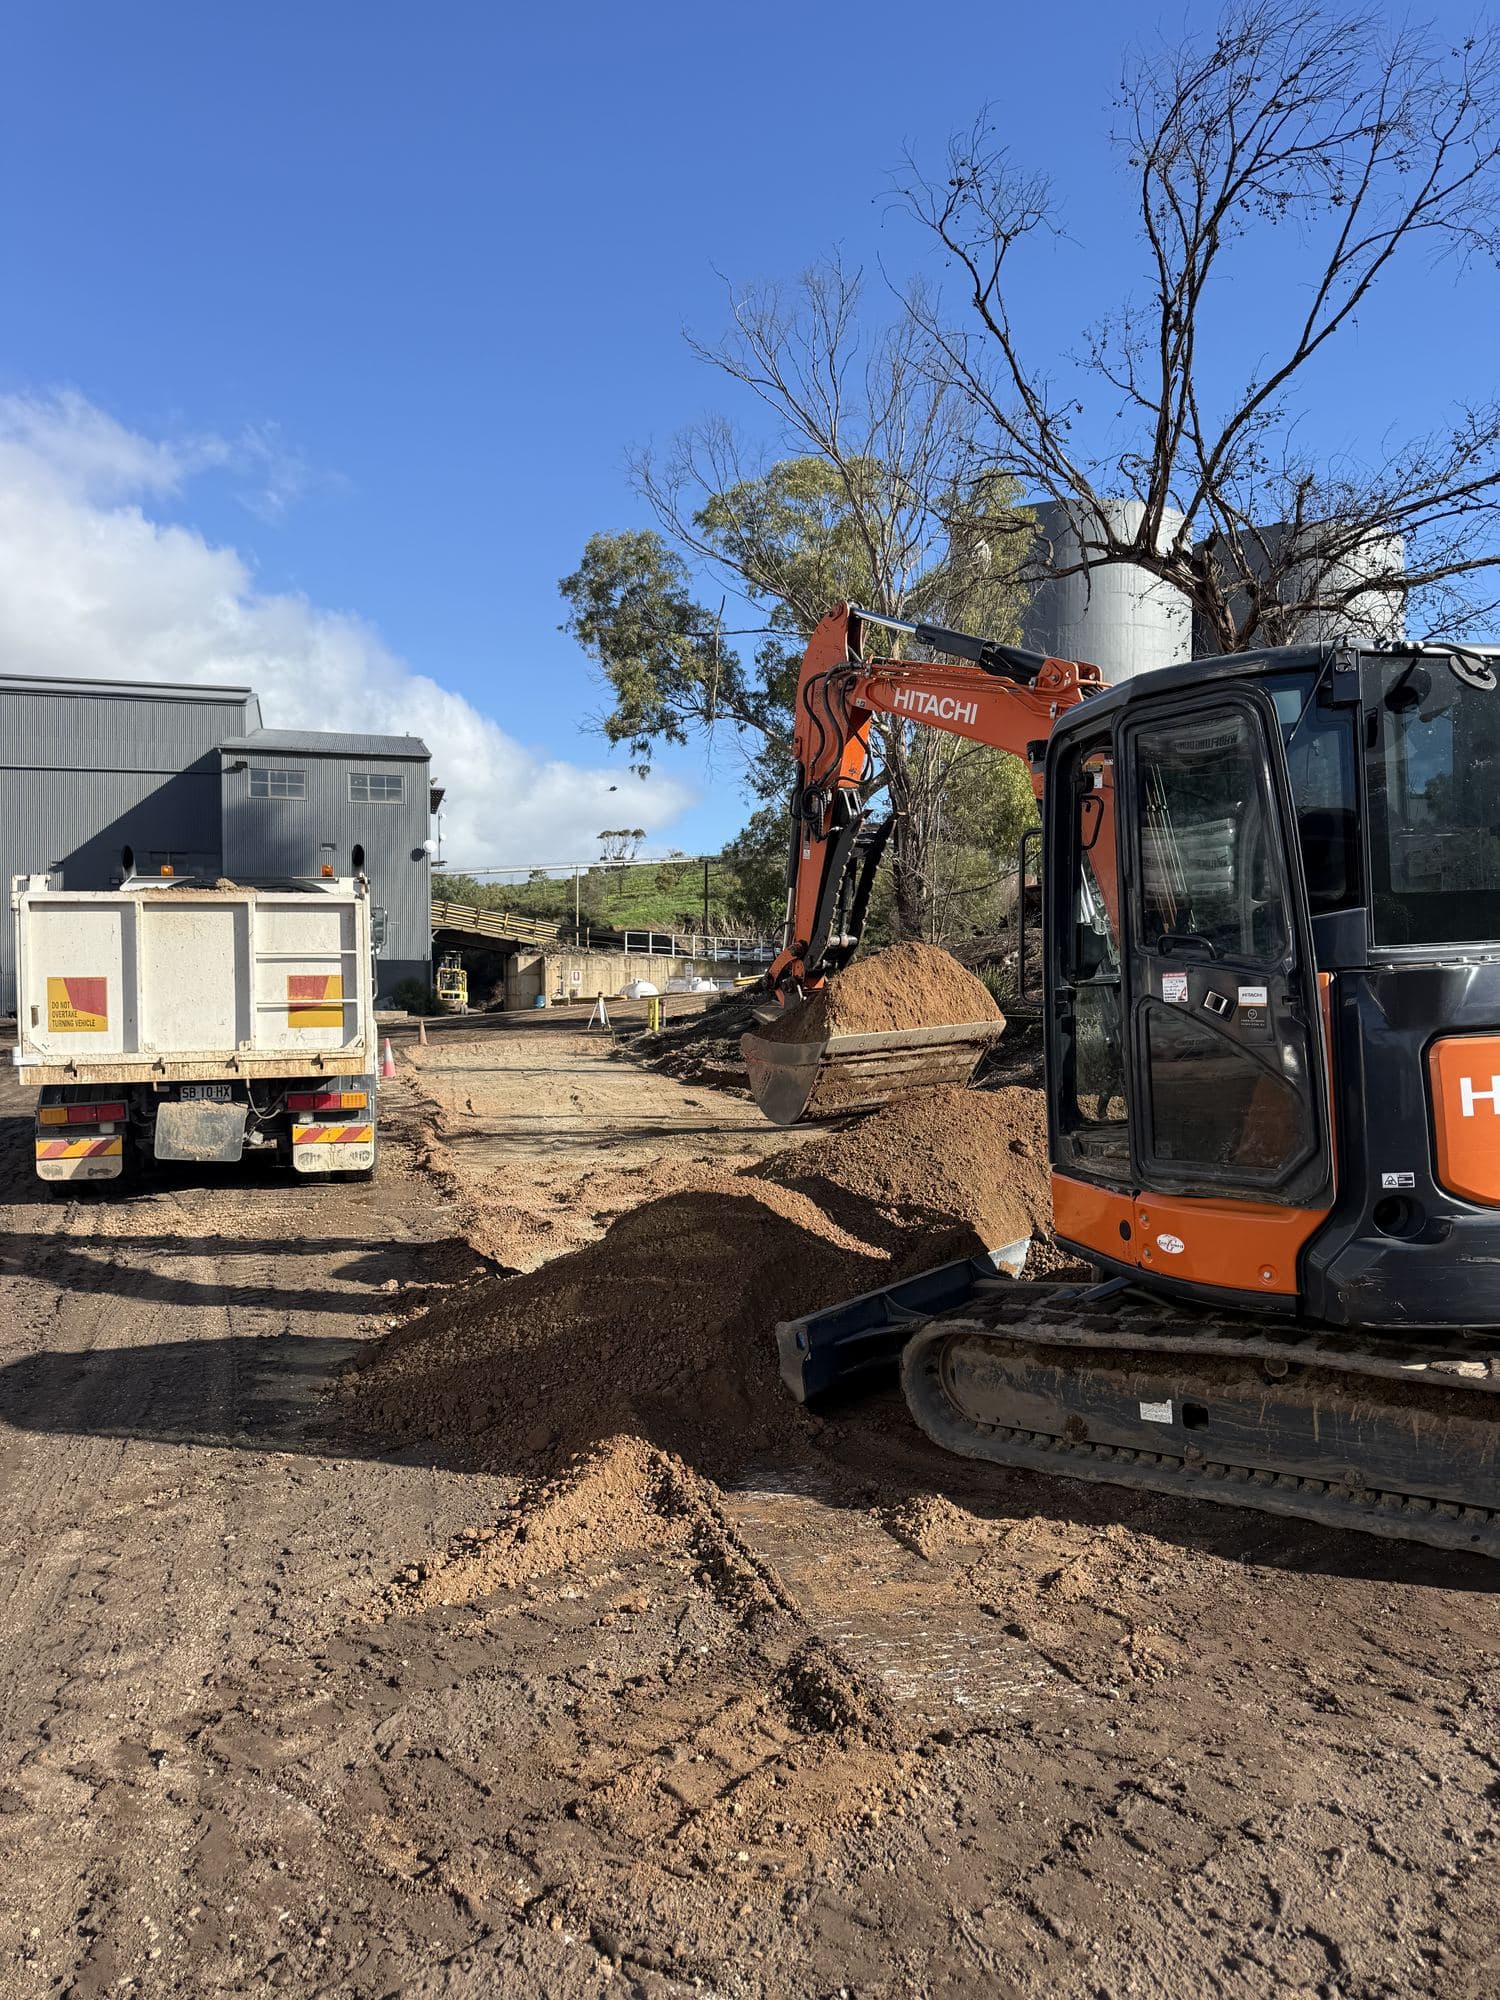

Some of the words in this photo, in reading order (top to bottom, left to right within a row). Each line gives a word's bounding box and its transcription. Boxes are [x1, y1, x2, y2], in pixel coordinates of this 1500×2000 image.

[893, 687, 978, 725] HITACHI
[51, 1001, 59, 1009] DO
[60, 1001, 70, 1009] NOT
[51, 1010, 78, 1018] OVERTAKE
[52, 1019, 74, 1028] TURNING
[75, 1019, 96, 1027] VEHICLE
